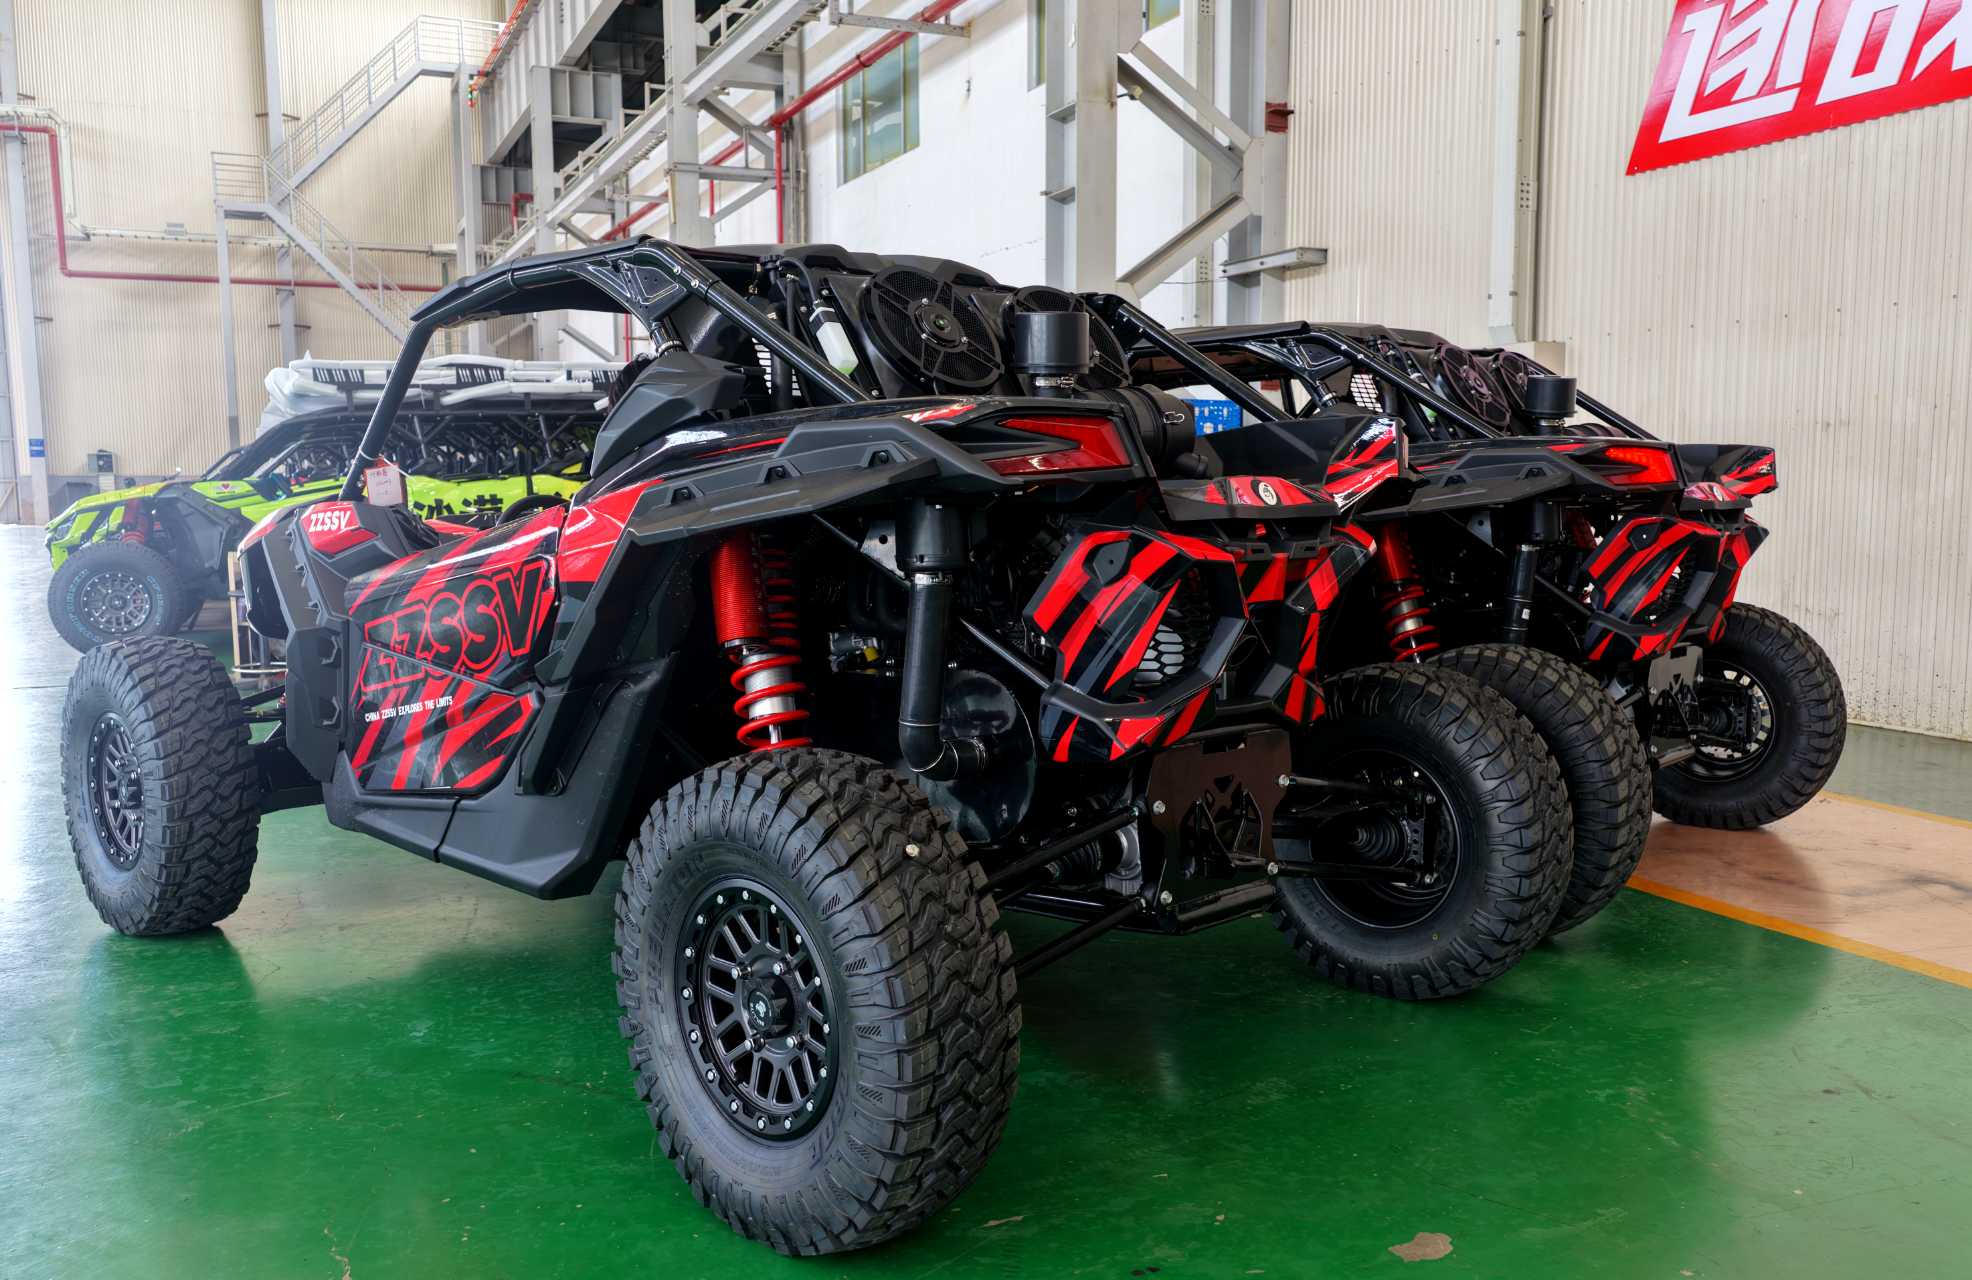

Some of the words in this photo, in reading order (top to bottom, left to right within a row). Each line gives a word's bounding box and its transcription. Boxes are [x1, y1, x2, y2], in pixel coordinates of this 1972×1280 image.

[309, 511, 351, 532] ZZSSV
[359, 560, 546, 692] ZZSSV
[365, 710, 380, 722] CHINA
[398, 702, 423, 716] EXPLORES
[424, 699, 434, 710] THE
